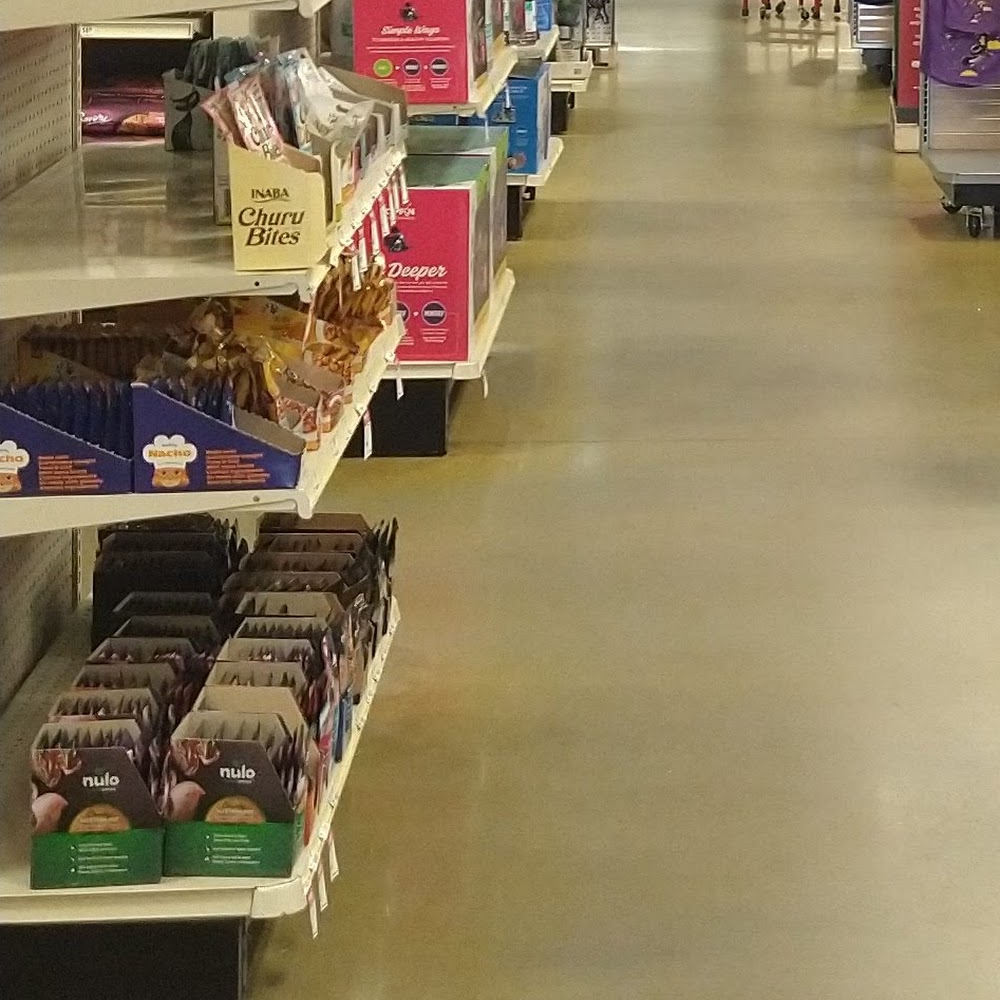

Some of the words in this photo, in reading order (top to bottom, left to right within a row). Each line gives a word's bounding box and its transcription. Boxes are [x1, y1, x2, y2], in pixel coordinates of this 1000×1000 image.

[251, 187, 290, 199] INABA
[238, 207, 305, 226] Churu
[245, 227, 300, 247] Bites
[388, 262, 447, 280] Deeper
[83, 772, 120, 788] nulo
[219, 764, 256, 779] nulo
